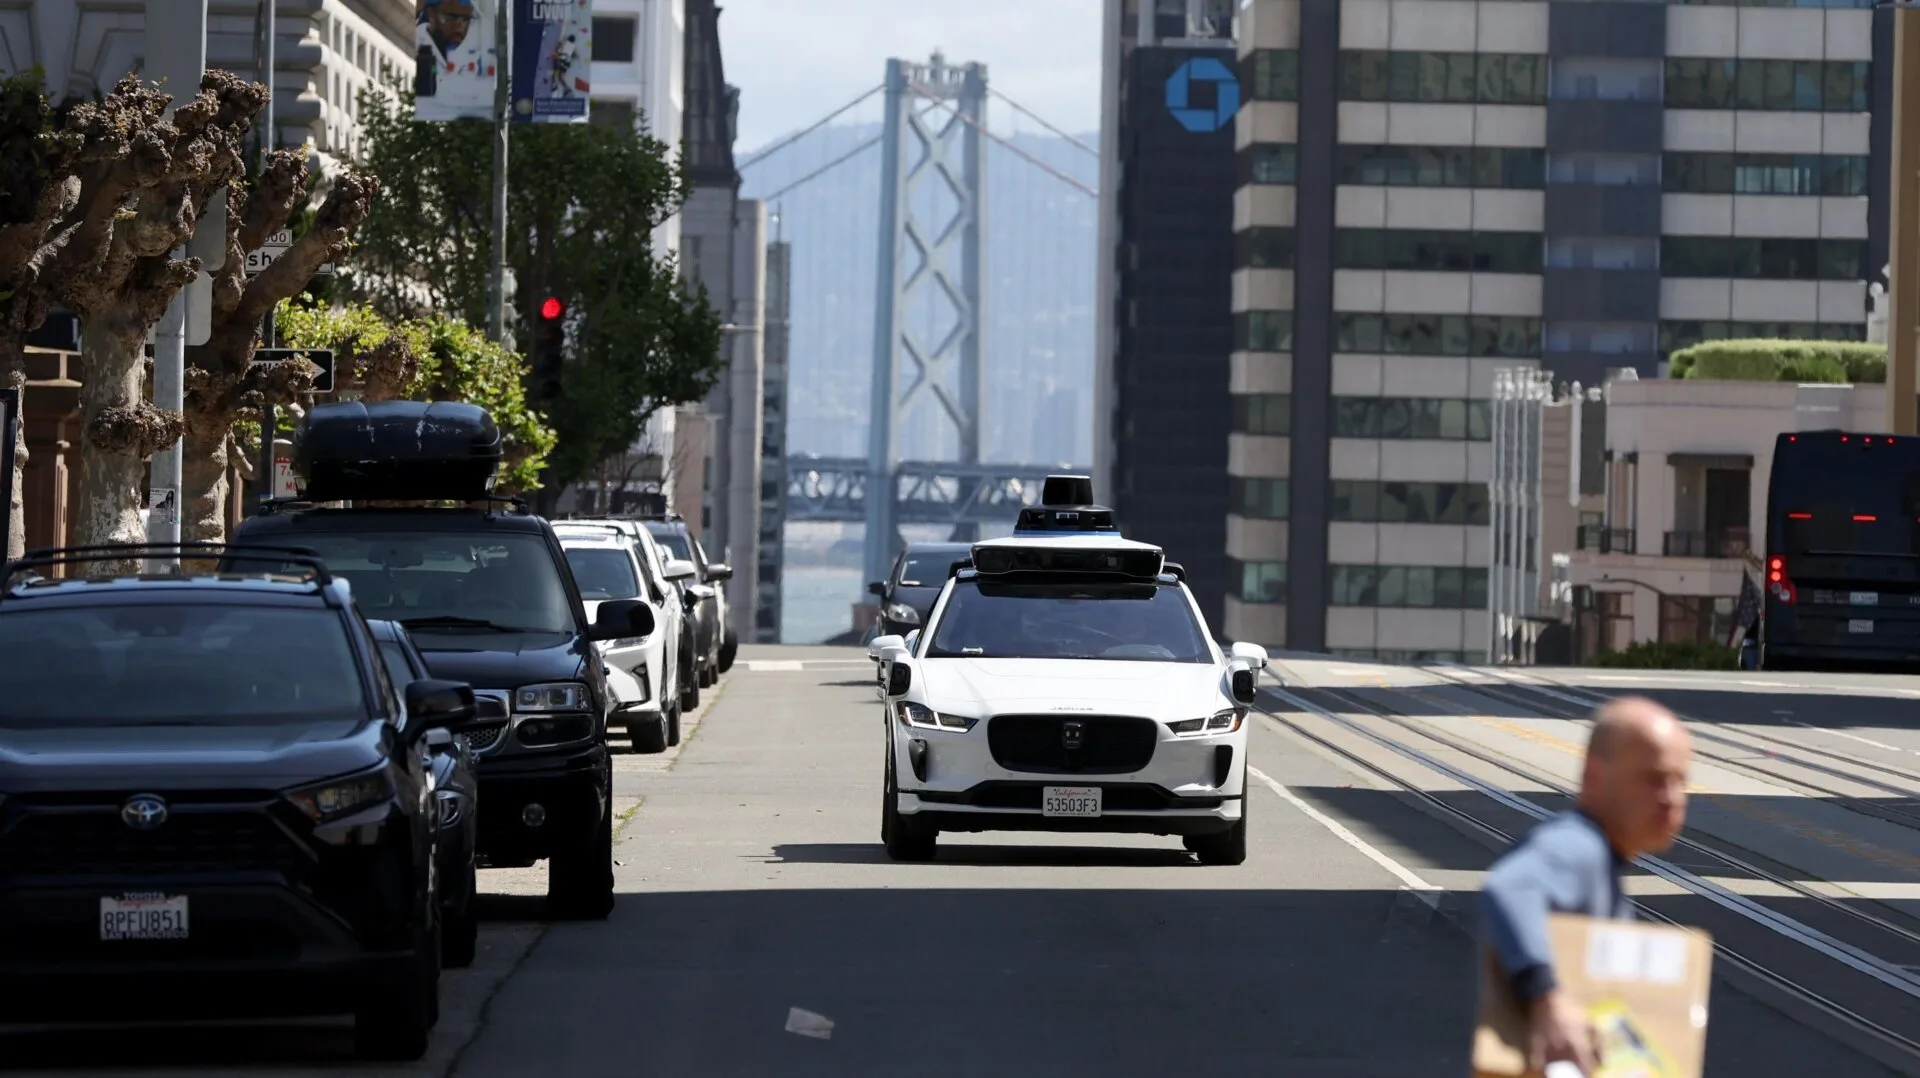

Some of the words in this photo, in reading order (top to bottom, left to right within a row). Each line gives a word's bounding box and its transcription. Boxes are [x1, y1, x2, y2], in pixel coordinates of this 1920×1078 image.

[1055, 789, 1088, 798] California
[1047, 798, 1098, 812] 53503F3
[124, 892, 166, 901] TOYOTA
[104, 909, 184, 933] 8PFU851
[127, 929, 189, 940] FRANCISCO
